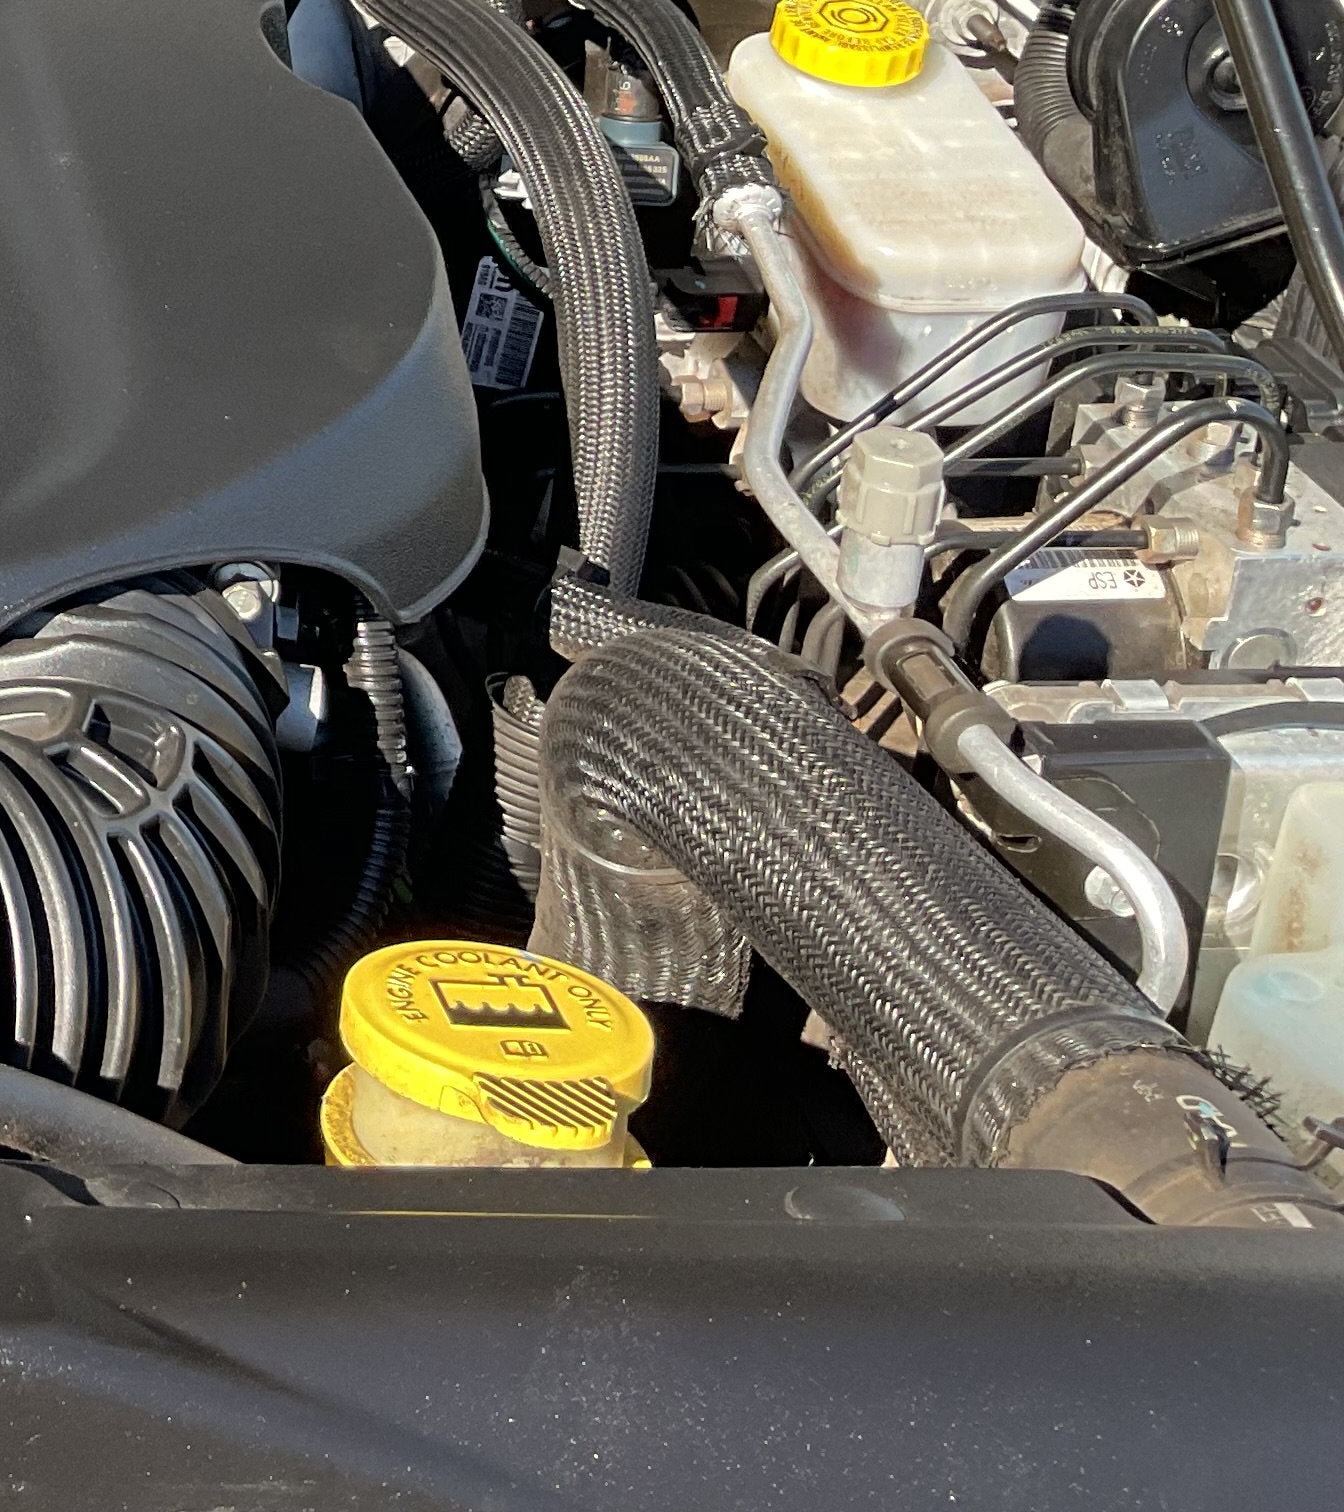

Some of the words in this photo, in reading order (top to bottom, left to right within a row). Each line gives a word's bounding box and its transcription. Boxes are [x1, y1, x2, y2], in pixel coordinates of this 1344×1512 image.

[1088, 571, 1118, 590] ESP
[386, 963, 430, 1024] ENGINE
[416, 950, 572, 983] COOLANT
[567, 985, 614, 1032] ONLY
